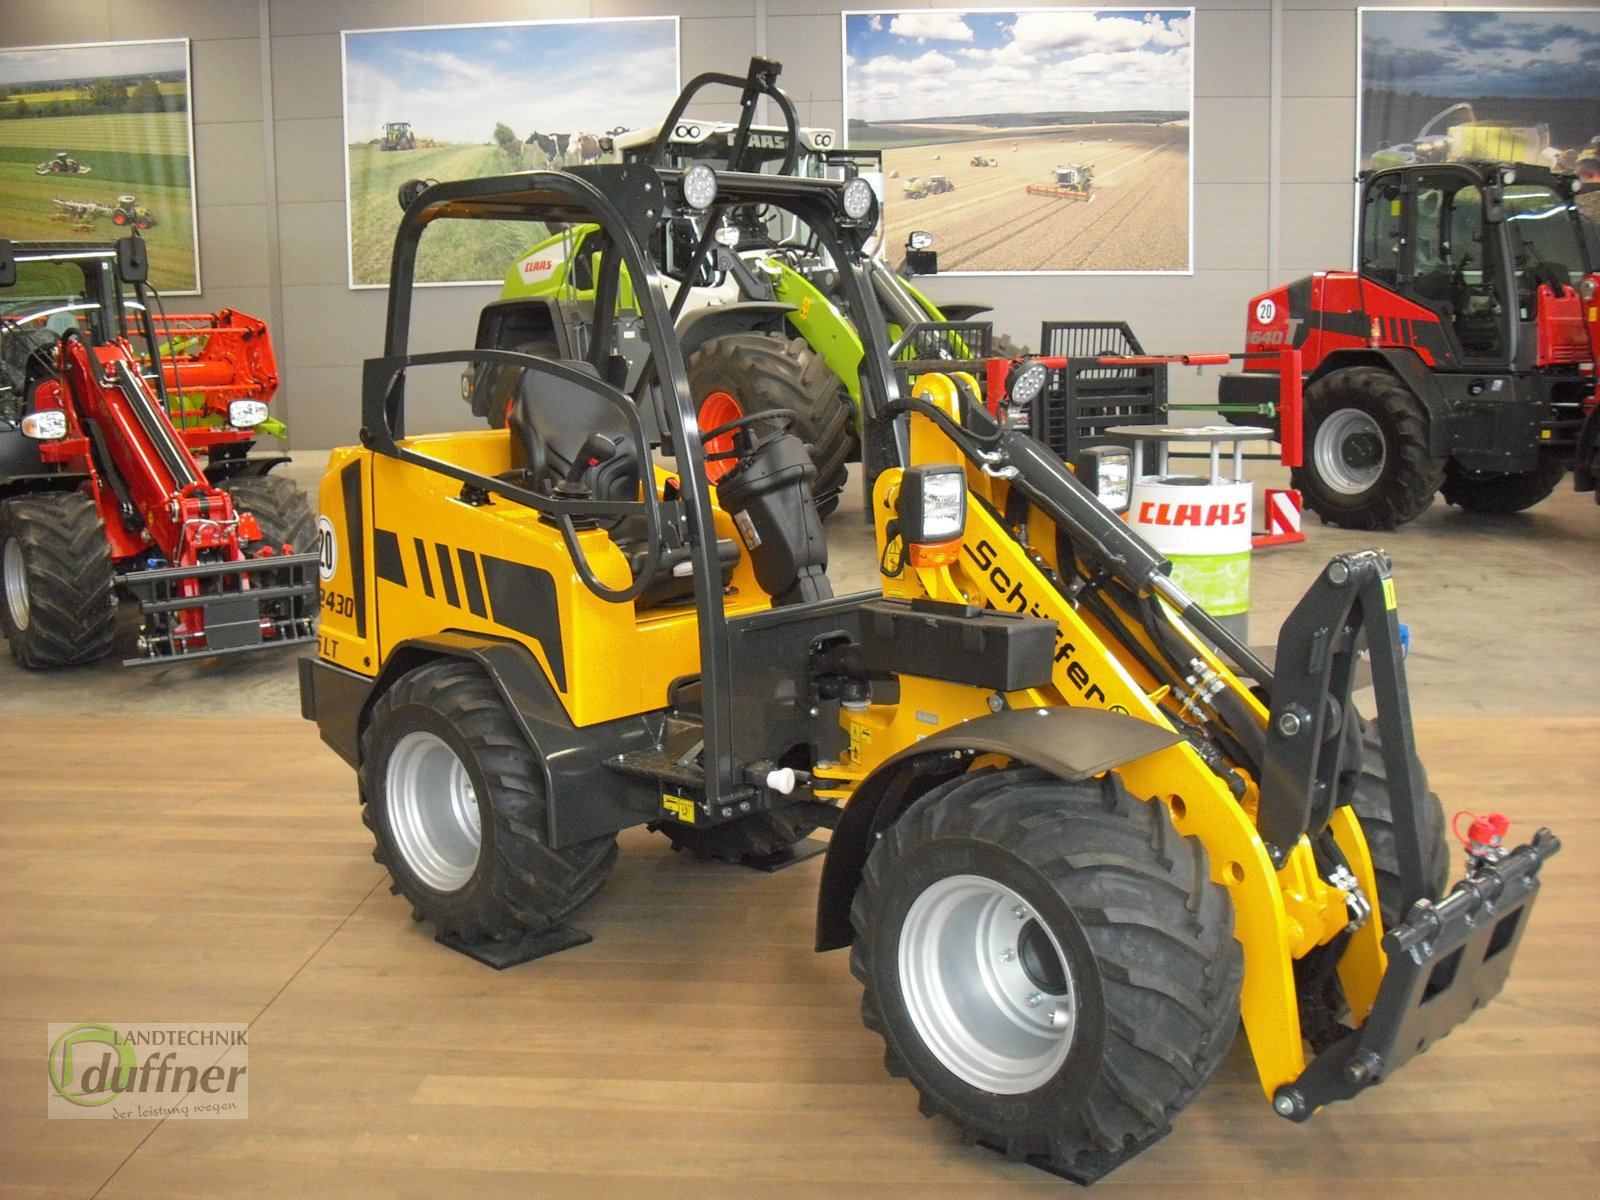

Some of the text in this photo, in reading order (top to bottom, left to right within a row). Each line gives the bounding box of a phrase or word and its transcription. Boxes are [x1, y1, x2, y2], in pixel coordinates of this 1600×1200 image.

[525, 260, 552, 273] CLAAS
[1260, 304, 1272, 319] 20
[1138, 502, 1247, 527] CLAAS
